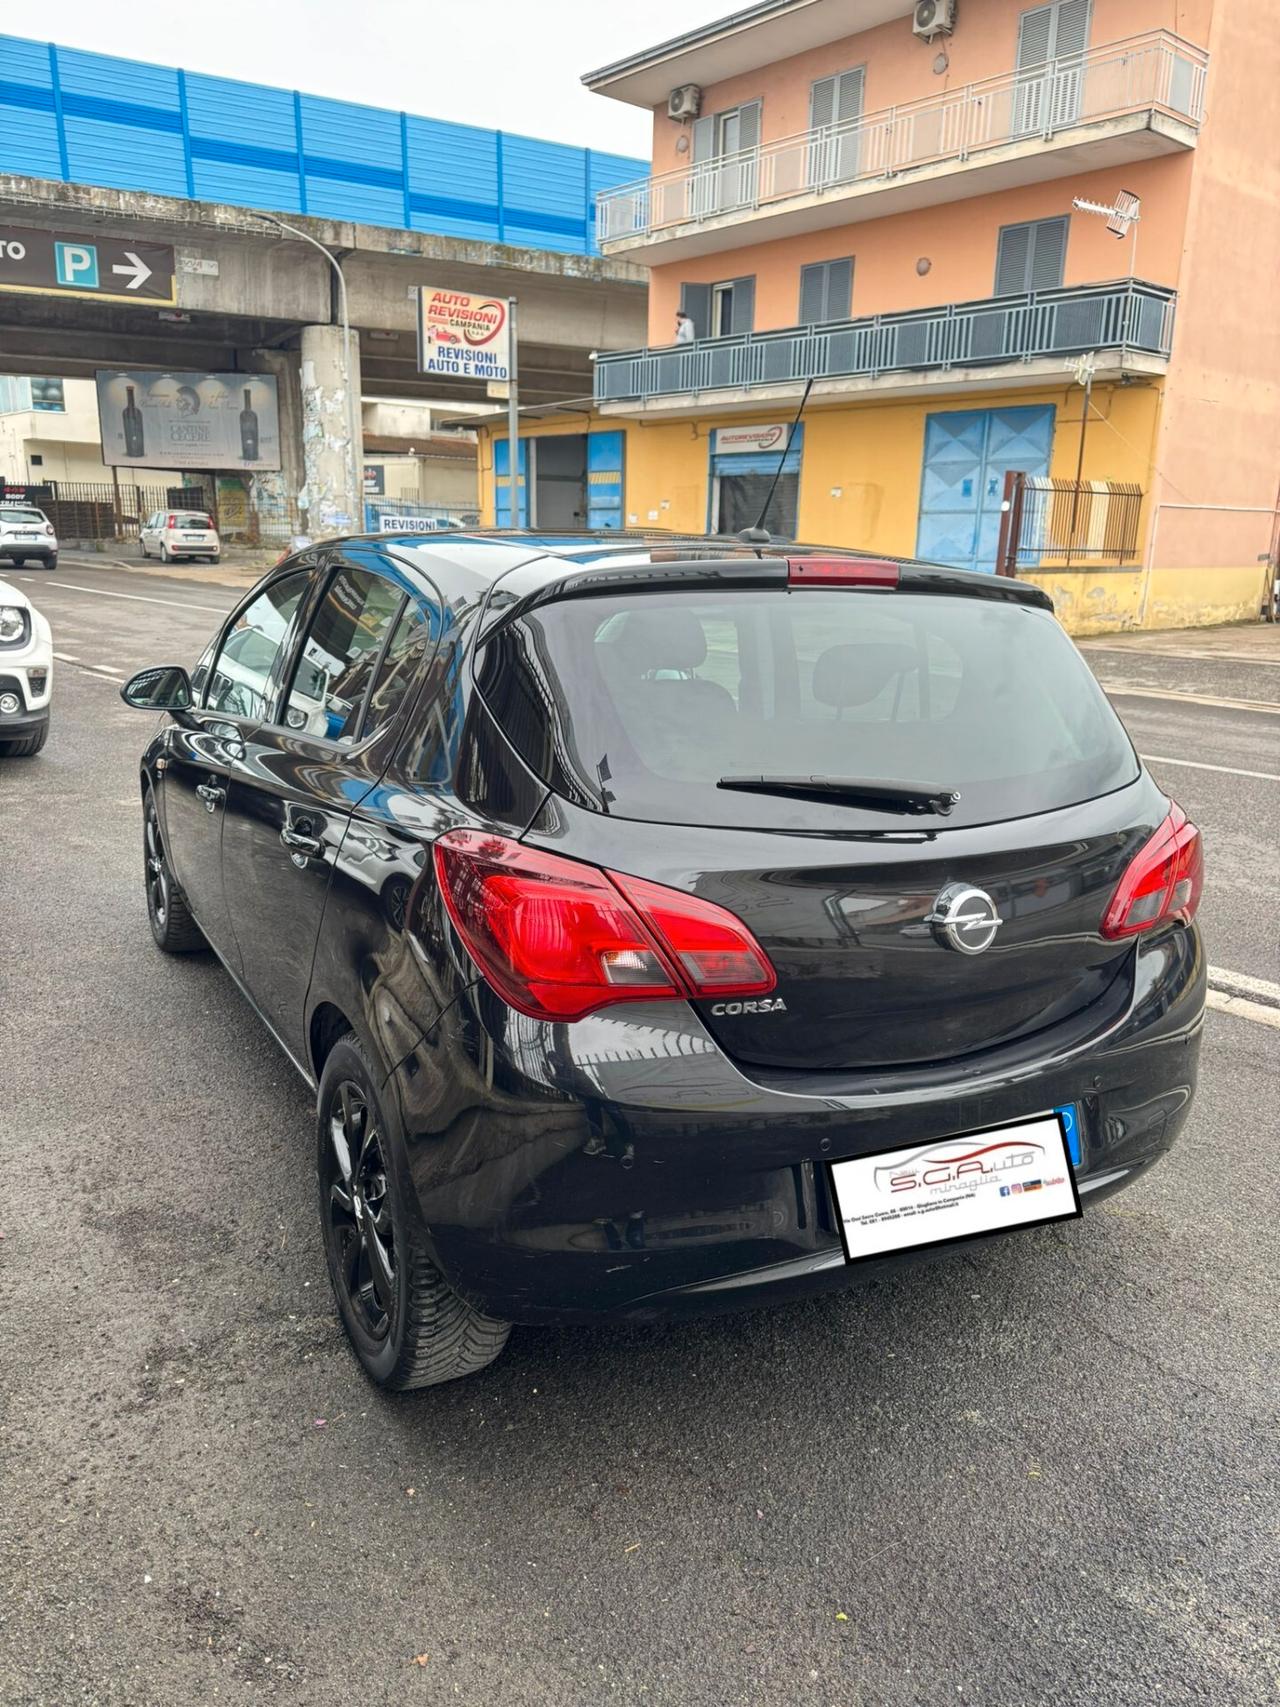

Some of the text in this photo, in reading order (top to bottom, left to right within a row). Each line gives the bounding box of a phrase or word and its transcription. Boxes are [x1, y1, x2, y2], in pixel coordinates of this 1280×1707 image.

[63, 246, 92, 281] P
[432, 292, 471, 307] AUTO
[428, 304, 498, 325] REVISIONI
[450, 319, 491, 331] CAMPANIA
[438, 346, 497, 364] REVISIONI
[428, 359, 507, 379] AUTO E MOTO
[384, 519, 436, 531] REVISIONI
[711, 998, 787, 1016] CORSA
